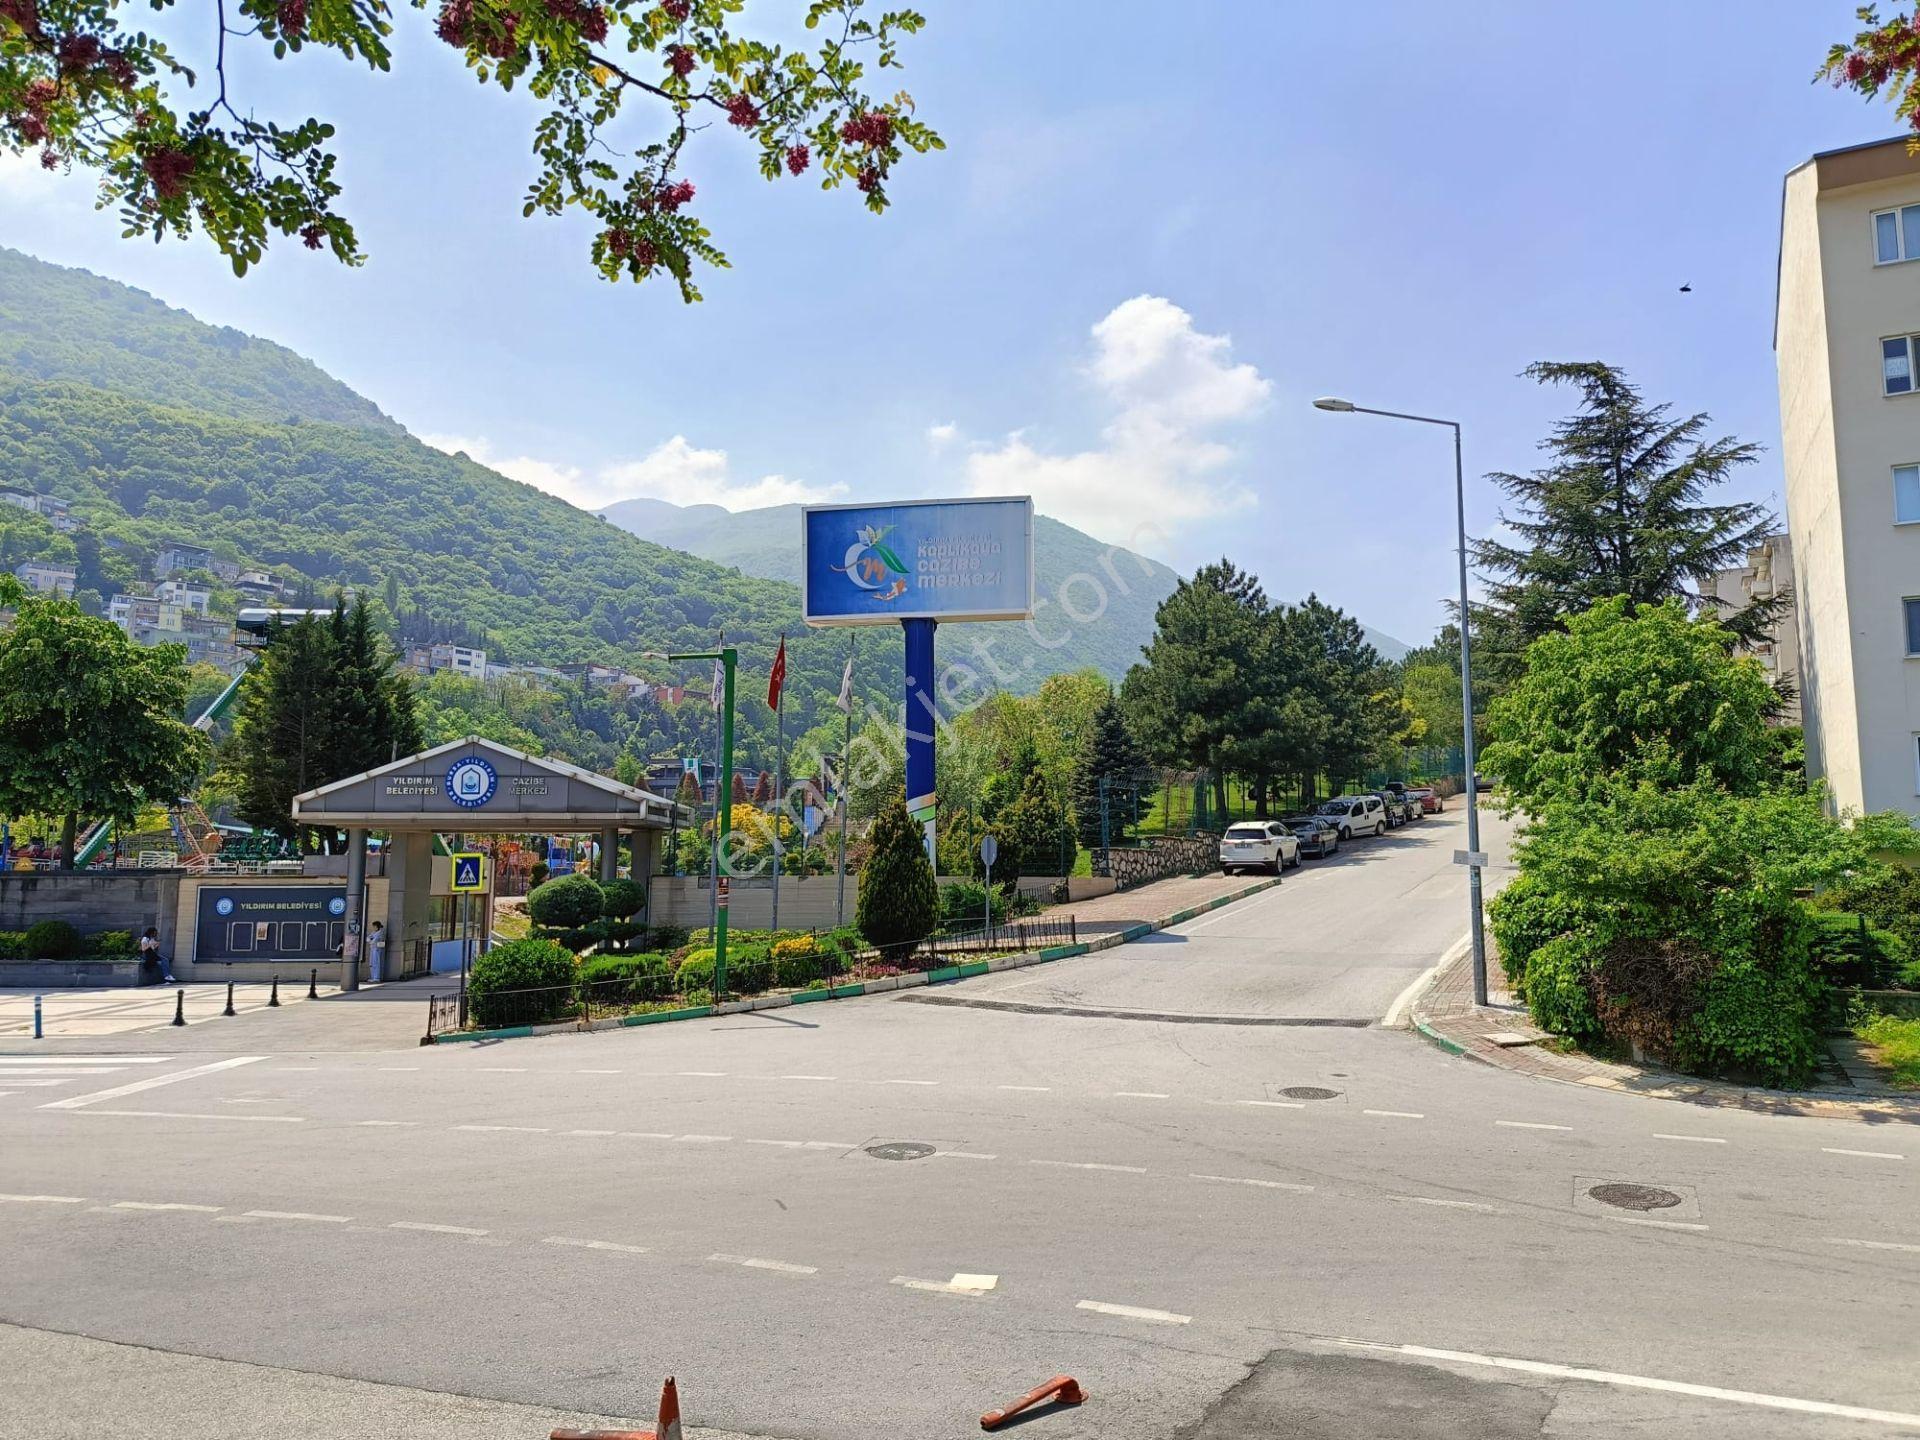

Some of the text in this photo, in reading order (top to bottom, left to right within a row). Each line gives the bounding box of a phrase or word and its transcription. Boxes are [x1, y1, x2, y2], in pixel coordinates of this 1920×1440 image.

[393, 777, 433, 786] YILDIRIM
[512, 777, 545, 786] CAZİBE
[386, 785, 438, 795] BELEDİYESİ
[240, 902, 275, 910] YILDIRIM
[276, 901, 322, 910] BELEDİYESİ
